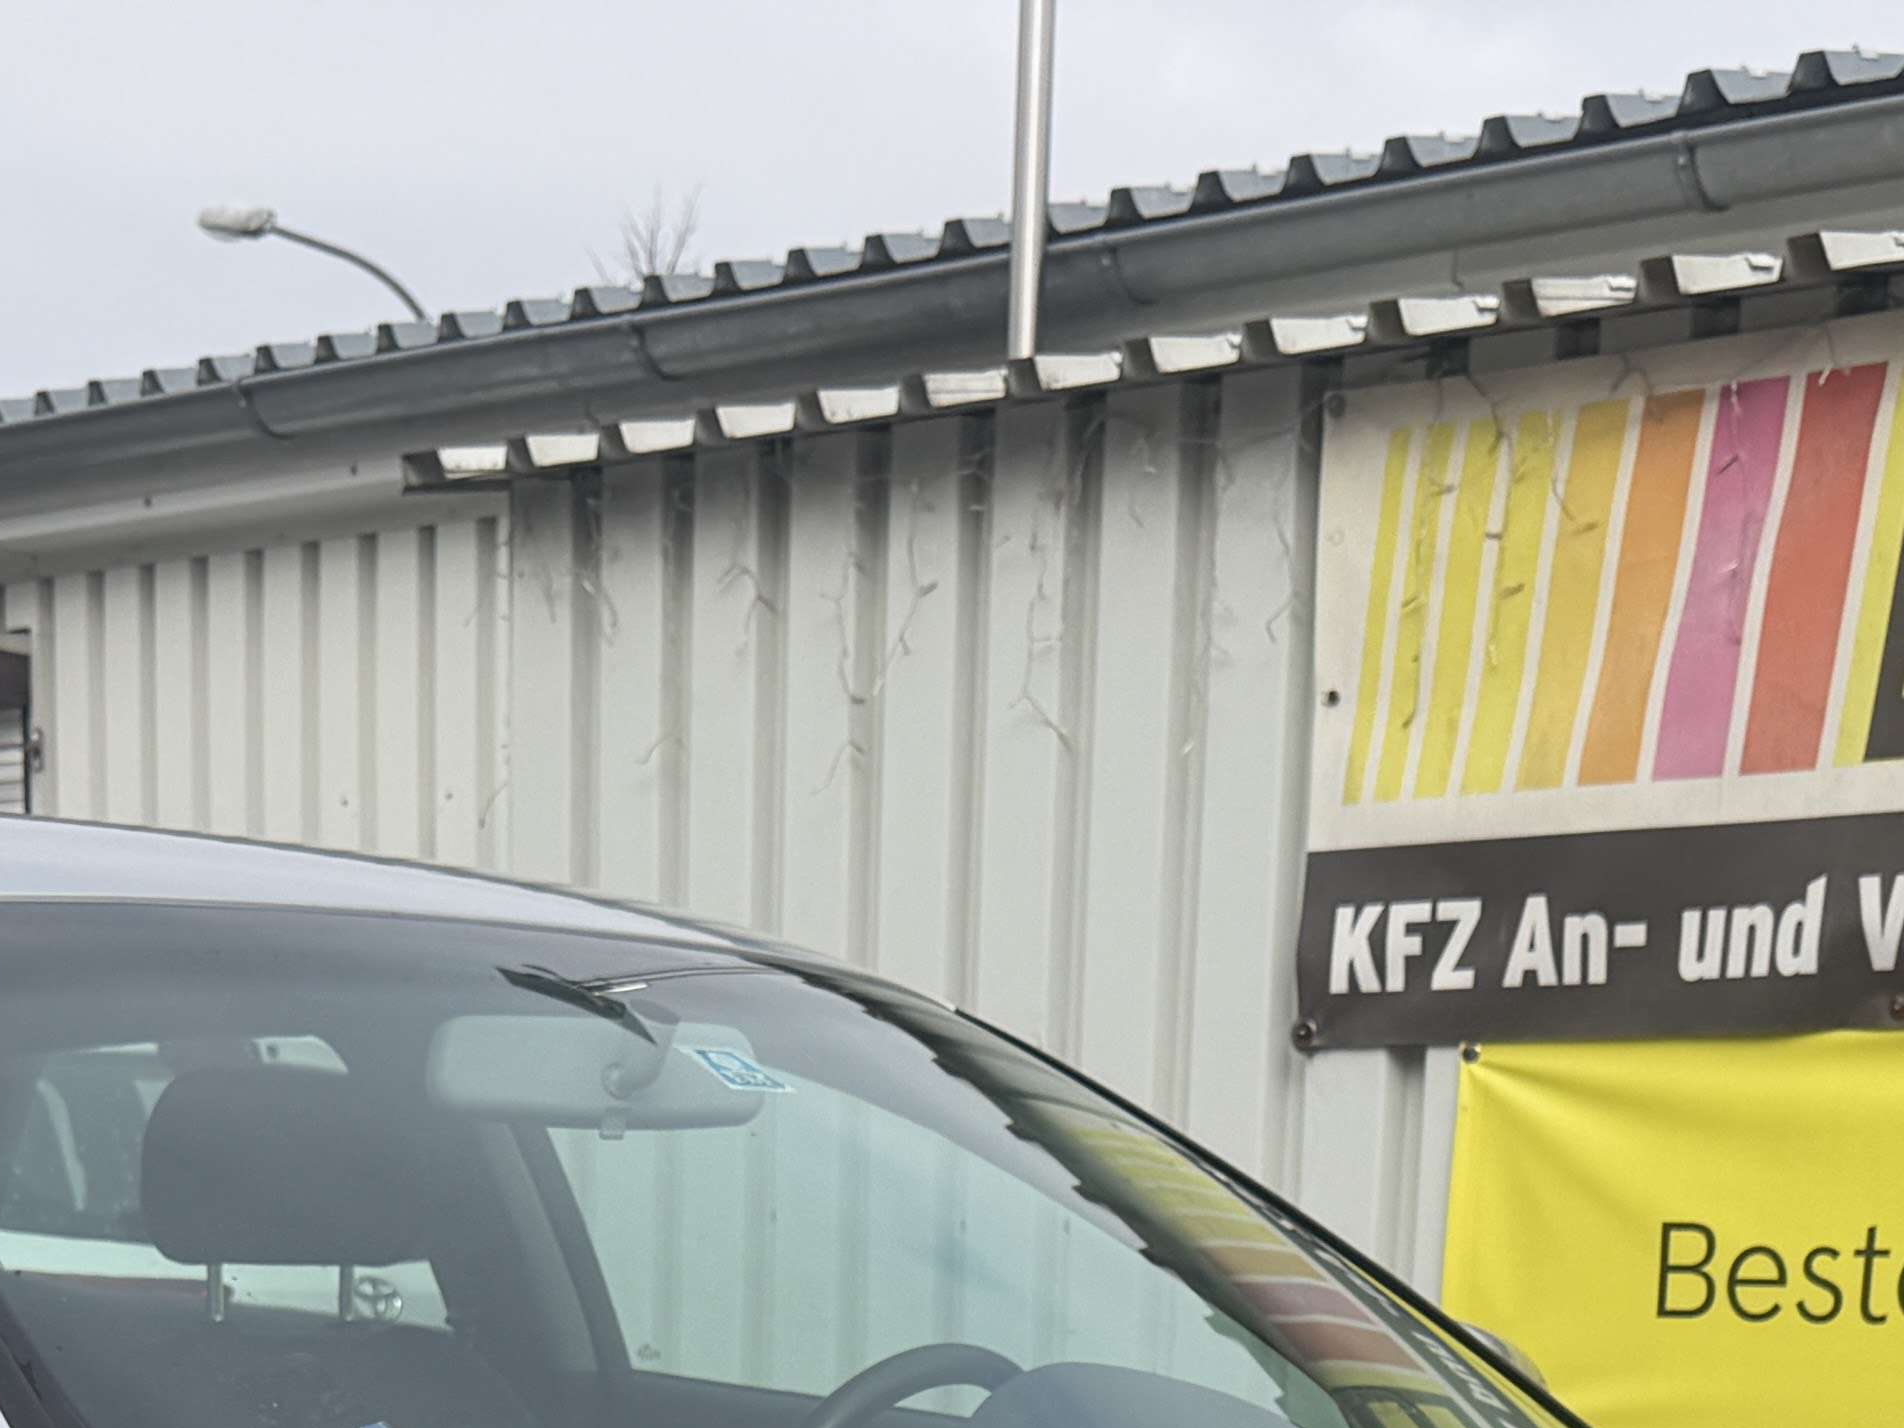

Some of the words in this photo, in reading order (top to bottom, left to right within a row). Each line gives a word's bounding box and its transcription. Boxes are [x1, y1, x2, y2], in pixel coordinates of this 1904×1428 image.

[1329, 897, 1482, 994] KFZ
[1503, 894, 1647, 989] An-
[1678, 875, 1828, 982] und
